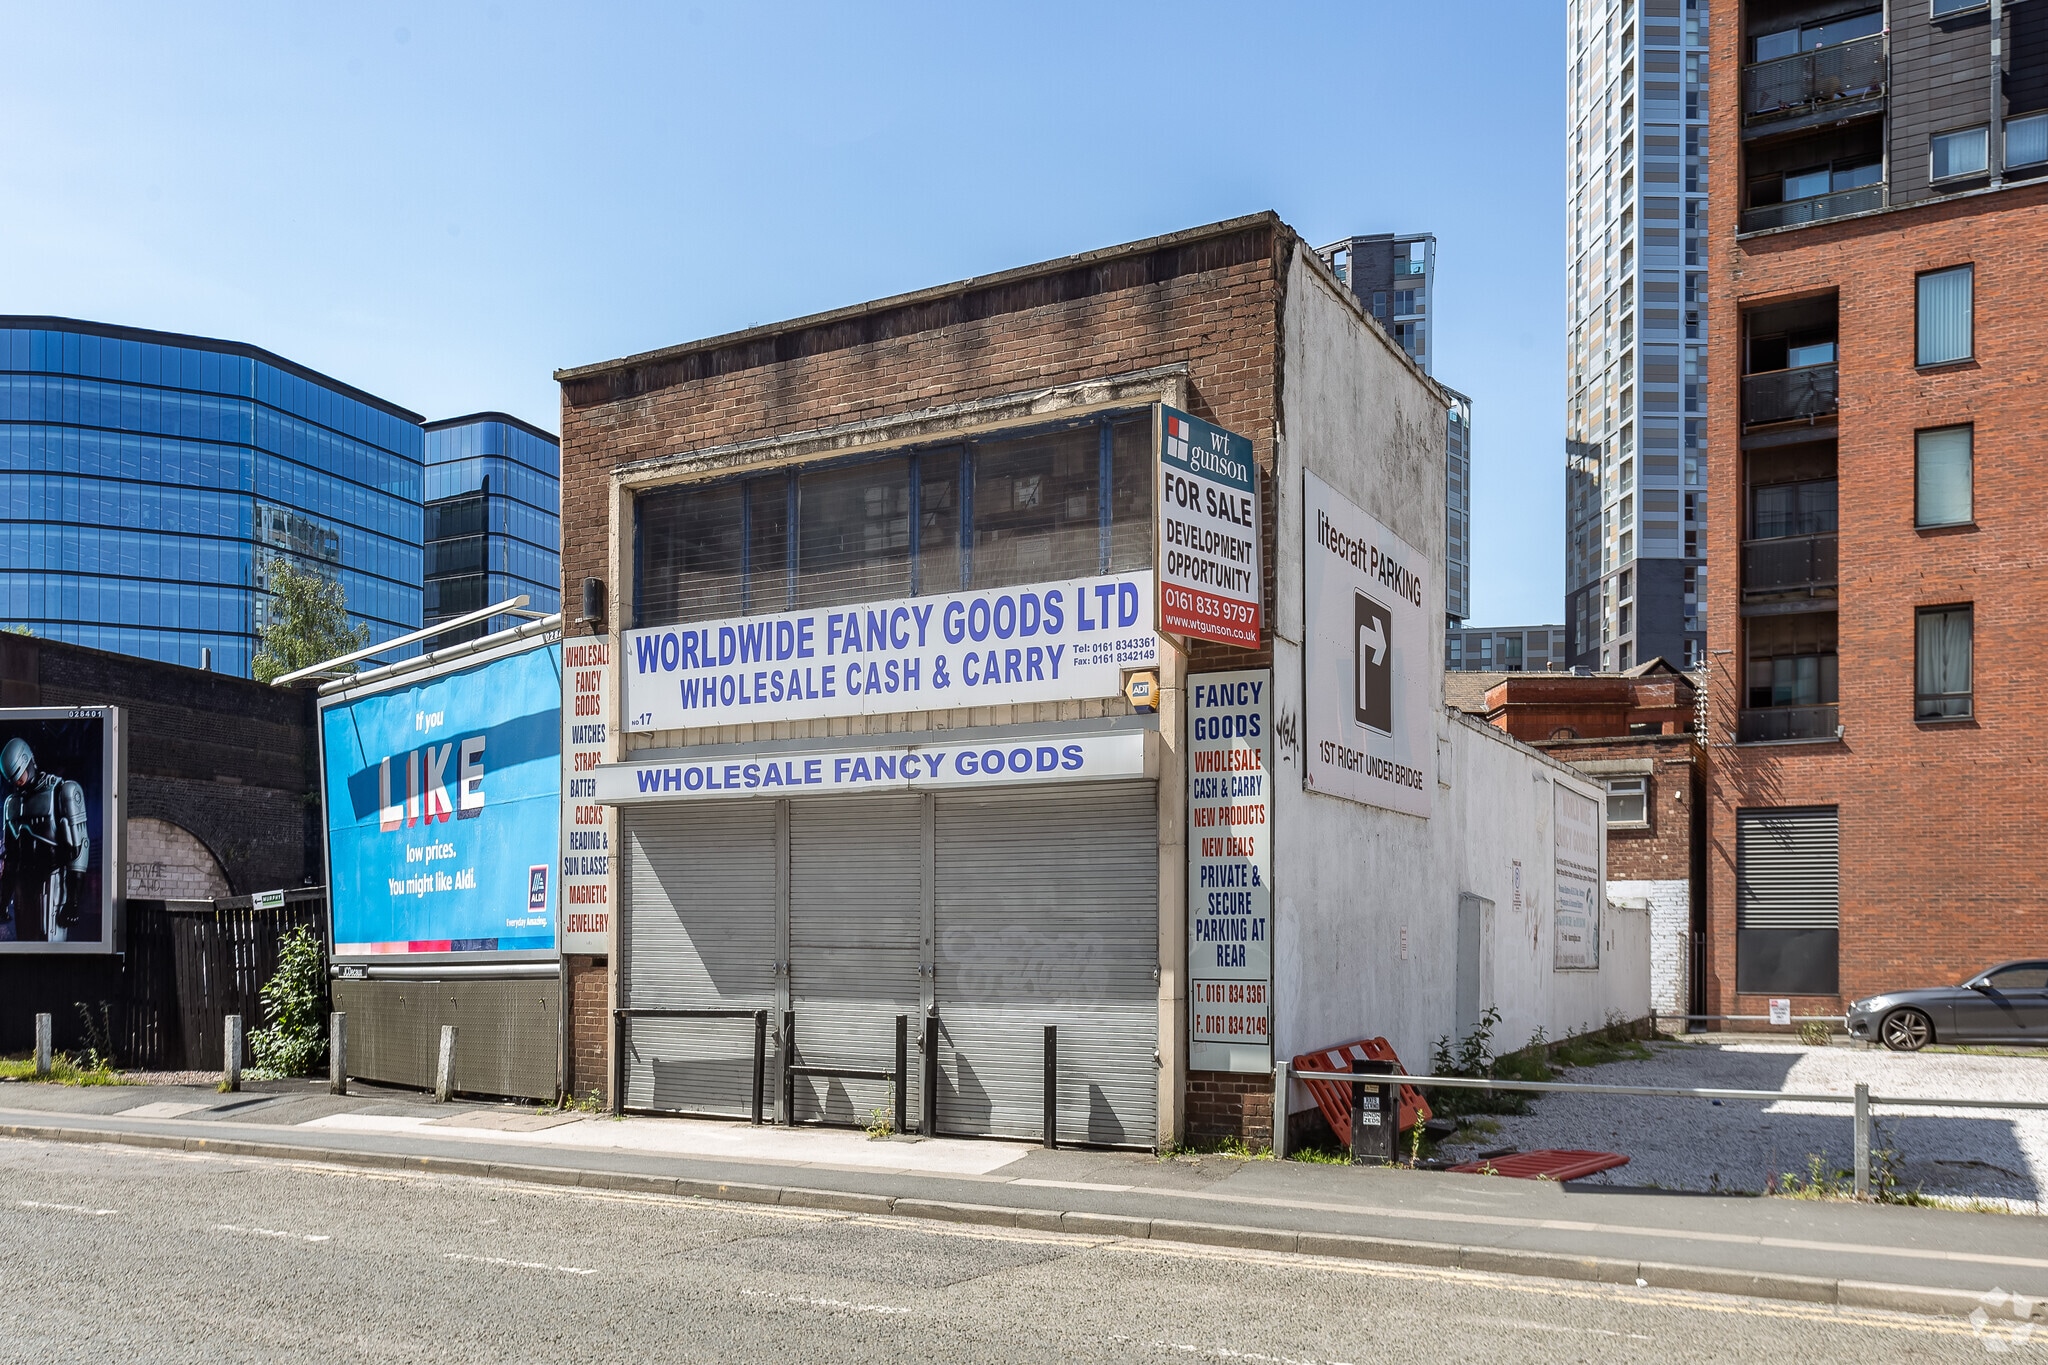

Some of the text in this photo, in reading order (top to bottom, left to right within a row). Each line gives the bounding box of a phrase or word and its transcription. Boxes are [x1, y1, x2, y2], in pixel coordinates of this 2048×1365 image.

[1210, 431, 1230, 456] wt
[1190, 445, 1248, 483] gunson
[1165, 471, 1253, 529] FOR SALE
[1166, 517, 1252, 565] DEVELOPMENT
[1317, 507, 1422, 609] litecraft PARKING
[1167, 550, 1251, 594] OPPORTUNITY
[1165, 588, 1255, 625] 0161 833 9797
[636, 581, 1139, 675] WORLDWIDE FANCY GOODS LTD
[1165, 612, 1257, 642] www.wtgunson.co.uk
[1073, 637, 1155, 653] Tel: 0161 8343361
[1073, 649, 1155, 666] Fax: 0161 8342149
[576, 670, 602, 693] FANCY
[680, 644, 1066, 710] WHOLESALE CASH & CARRY
[1133, 683, 1148, 695] ADT
[575, 694, 601, 717] GOODS
[1195, 681, 1263, 708] FANCY
[424, 710, 443, 734] you
[640, 713, 652, 725] 17
[1195, 713, 1261, 741] GOODS
[572, 723, 606, 744] WATCHES
[574, 751, 602, 772] STRAPS
[637, 745, 1084, 793] WHOLESALE FANCY GOODS
[1194, 749, 1261, 773] WHOLESALE
[1319, 739, 1423, 791] 1ST RIGHT UNDER BRIDGE
[379, 735, 485, 833] LIKE
[570, 778, 596, 798] BATTER
[1194, 775, 1262, 799] CASH & CARRY
[575, 805, 603, 825] CLOCKS
[1194, 804, 1265, 828] NEW PRODUCTS
[406, 839, 456, 865] low prices.
[570, 831, 608, 851] READING &
[1202, 836, 1254, 857] NEW DEALS
[565, 856, 579, 876] SUN
[1200, 864, 1261, 888] PRIVATE &
[388, 867, 476, 899] You might like Aldi.
[569, 884, 607, 904] MAGNETIC
[531, 892, 544, 902] ALDI
[1208, 892, 1252, 916] SECURE
[567, 913, 609, 933] JEWELLERY
[1196, 917, 1266, 942] PARKING AT
[1216, 944, 1246, 967] REAR
[1196, 983, 1266, 1004] T. 0161 834 3361
[1196, 1014, 1267, 1036] F. 0161 834 2149
